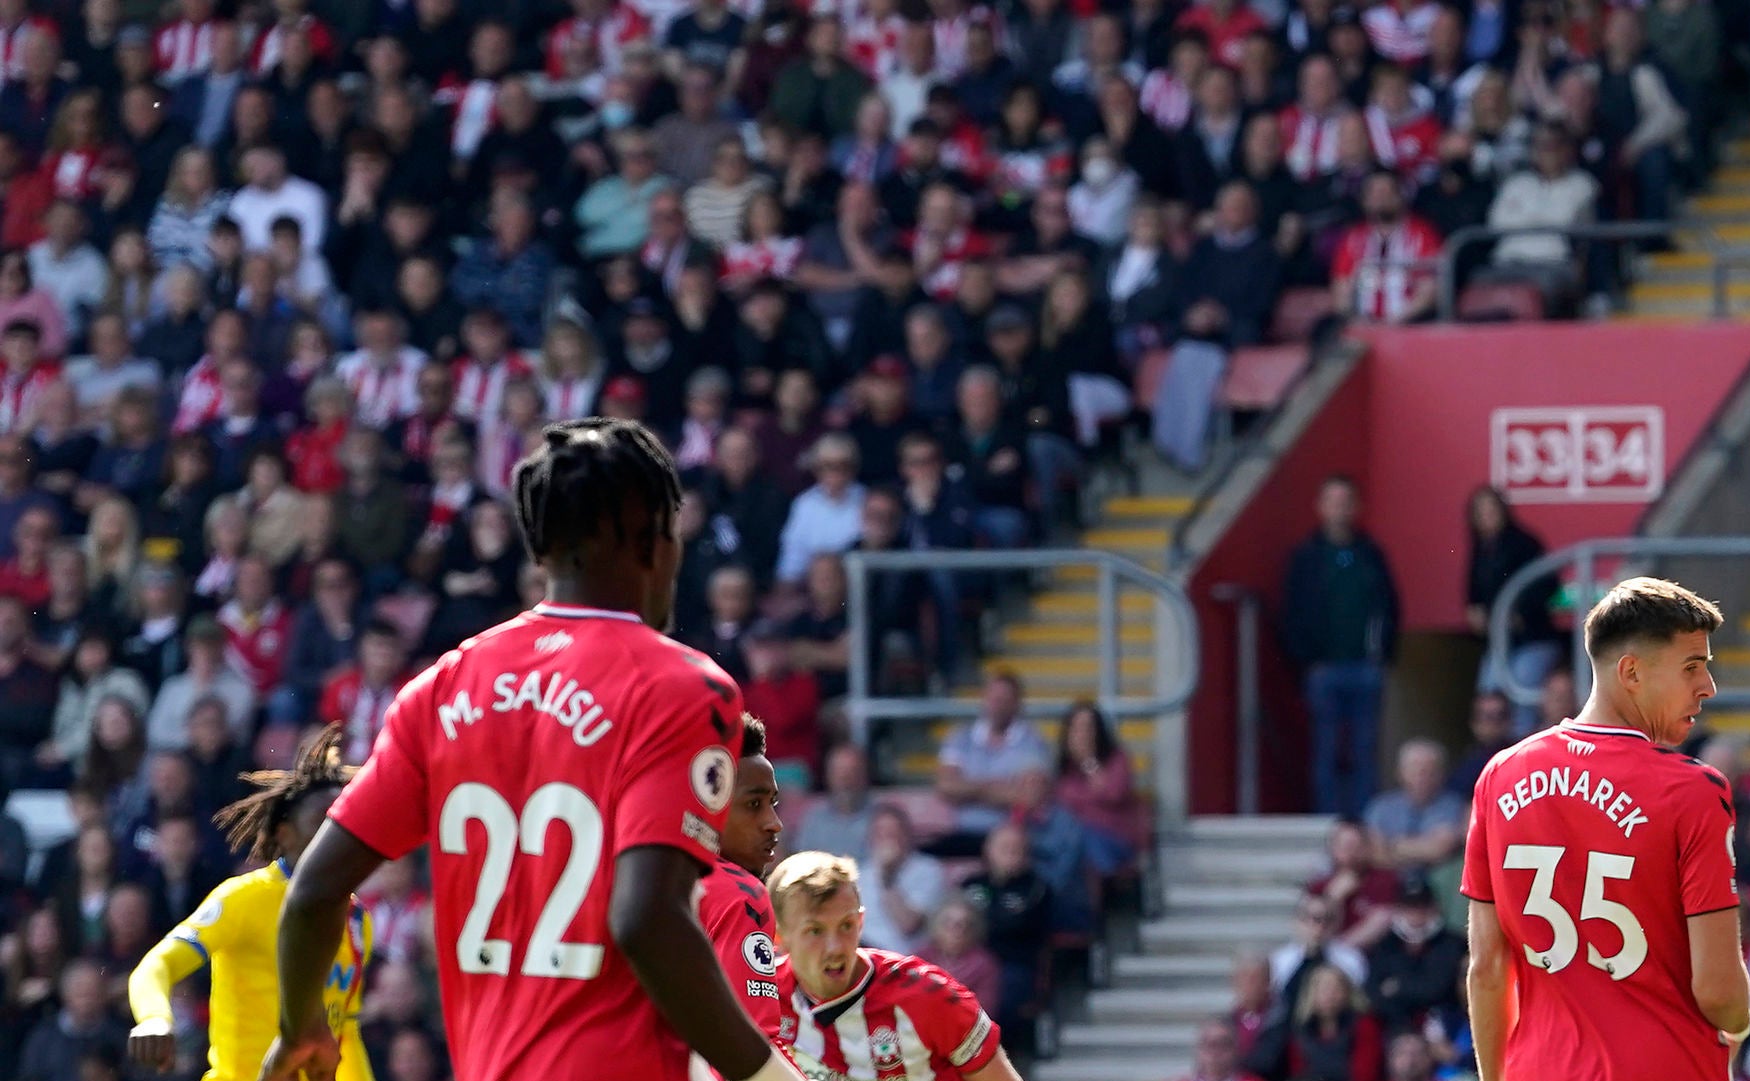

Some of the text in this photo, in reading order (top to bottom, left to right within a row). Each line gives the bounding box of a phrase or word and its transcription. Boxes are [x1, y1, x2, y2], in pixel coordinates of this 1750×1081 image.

[1505, 426, 1646, 484] 33 34
[438, 670, 613, 747] M. SALISU
[1497, 767, 1648, 838] BEDNAREK
[439, 782, 605, 980] 22
[1502, 844, 1648, 981] 35
[747, 980, 760, 990] No
